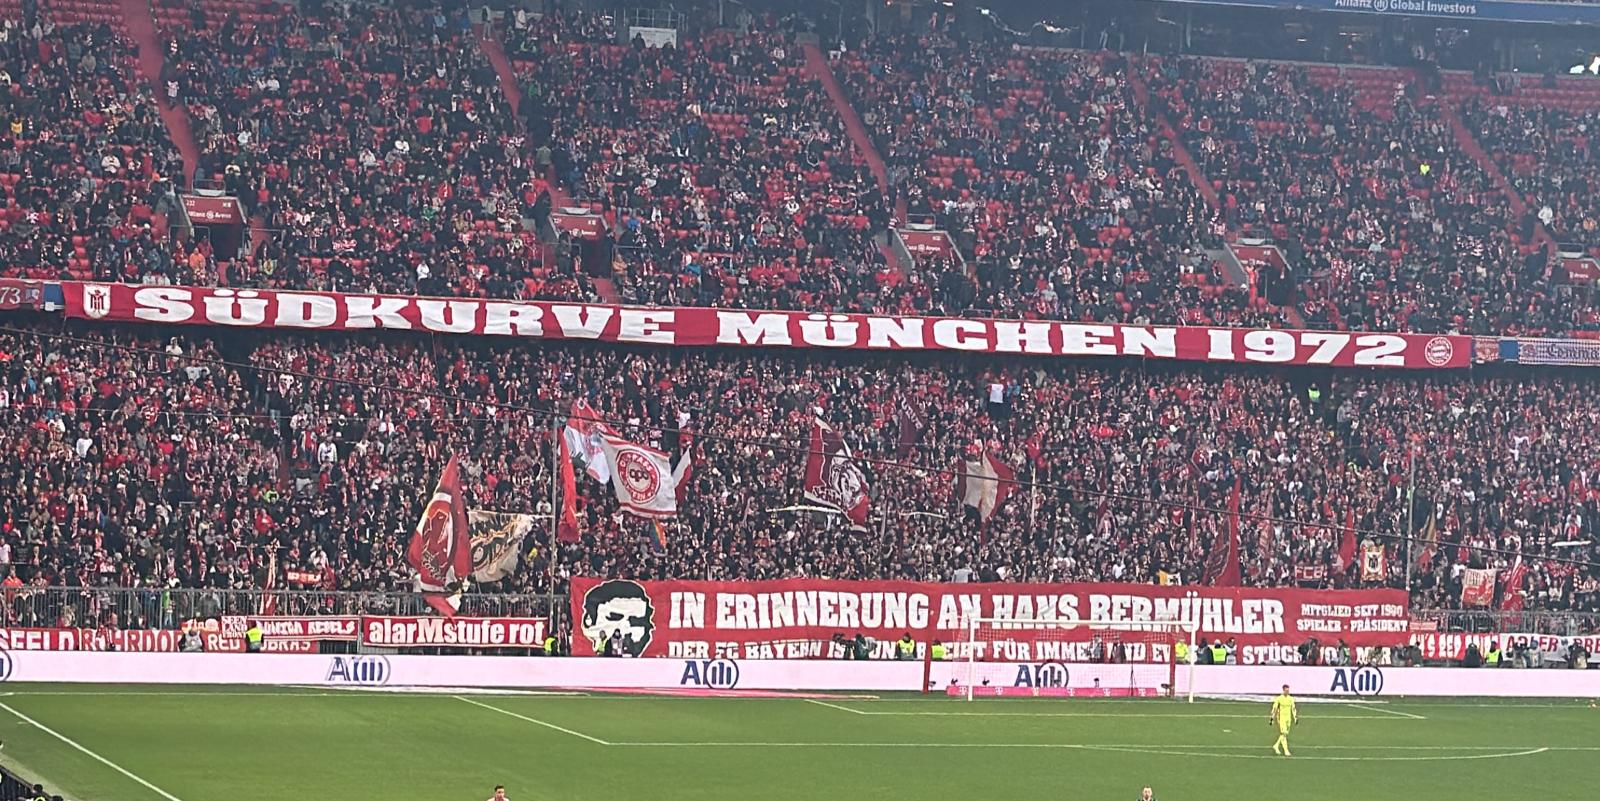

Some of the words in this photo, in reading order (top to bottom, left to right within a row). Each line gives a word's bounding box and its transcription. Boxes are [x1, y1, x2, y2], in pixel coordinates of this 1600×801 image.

[1390, 0, 1424, 11] Global
[1427, 2, 1476, 14] Investors
[134, 287, 675, 345] SÜDKURVE
[716, 311, 1177, 358] MÜNCHEN
[1207, 328, 1408, 367] 1972
[669, 592, 706, 629] IN
[716, 591, 929, 630] ERINNERUNG
[936, 594, 982, 630] AN
[992, 594, 1079, 630] HANS
[1089, 591, 1285, 633] BERMÜHLER
[1301, 603, 1352, 617] MITGLIED
[1353, 604, 1379, 617] SEIT
[368, 618, 505, 644] alarMstufe
[508, 620, 545, 645] rot
[1296, 618, 1342, 632] SPIELER
[1350, 617, 1408, 632] PRÄSIDENT
[668, 641, 709, 659] DER
[744, 639, 822, 660] BAYERN
[992, 639, 1030, 661] FÜR
[1036, 641, 1099, 662] IMME
